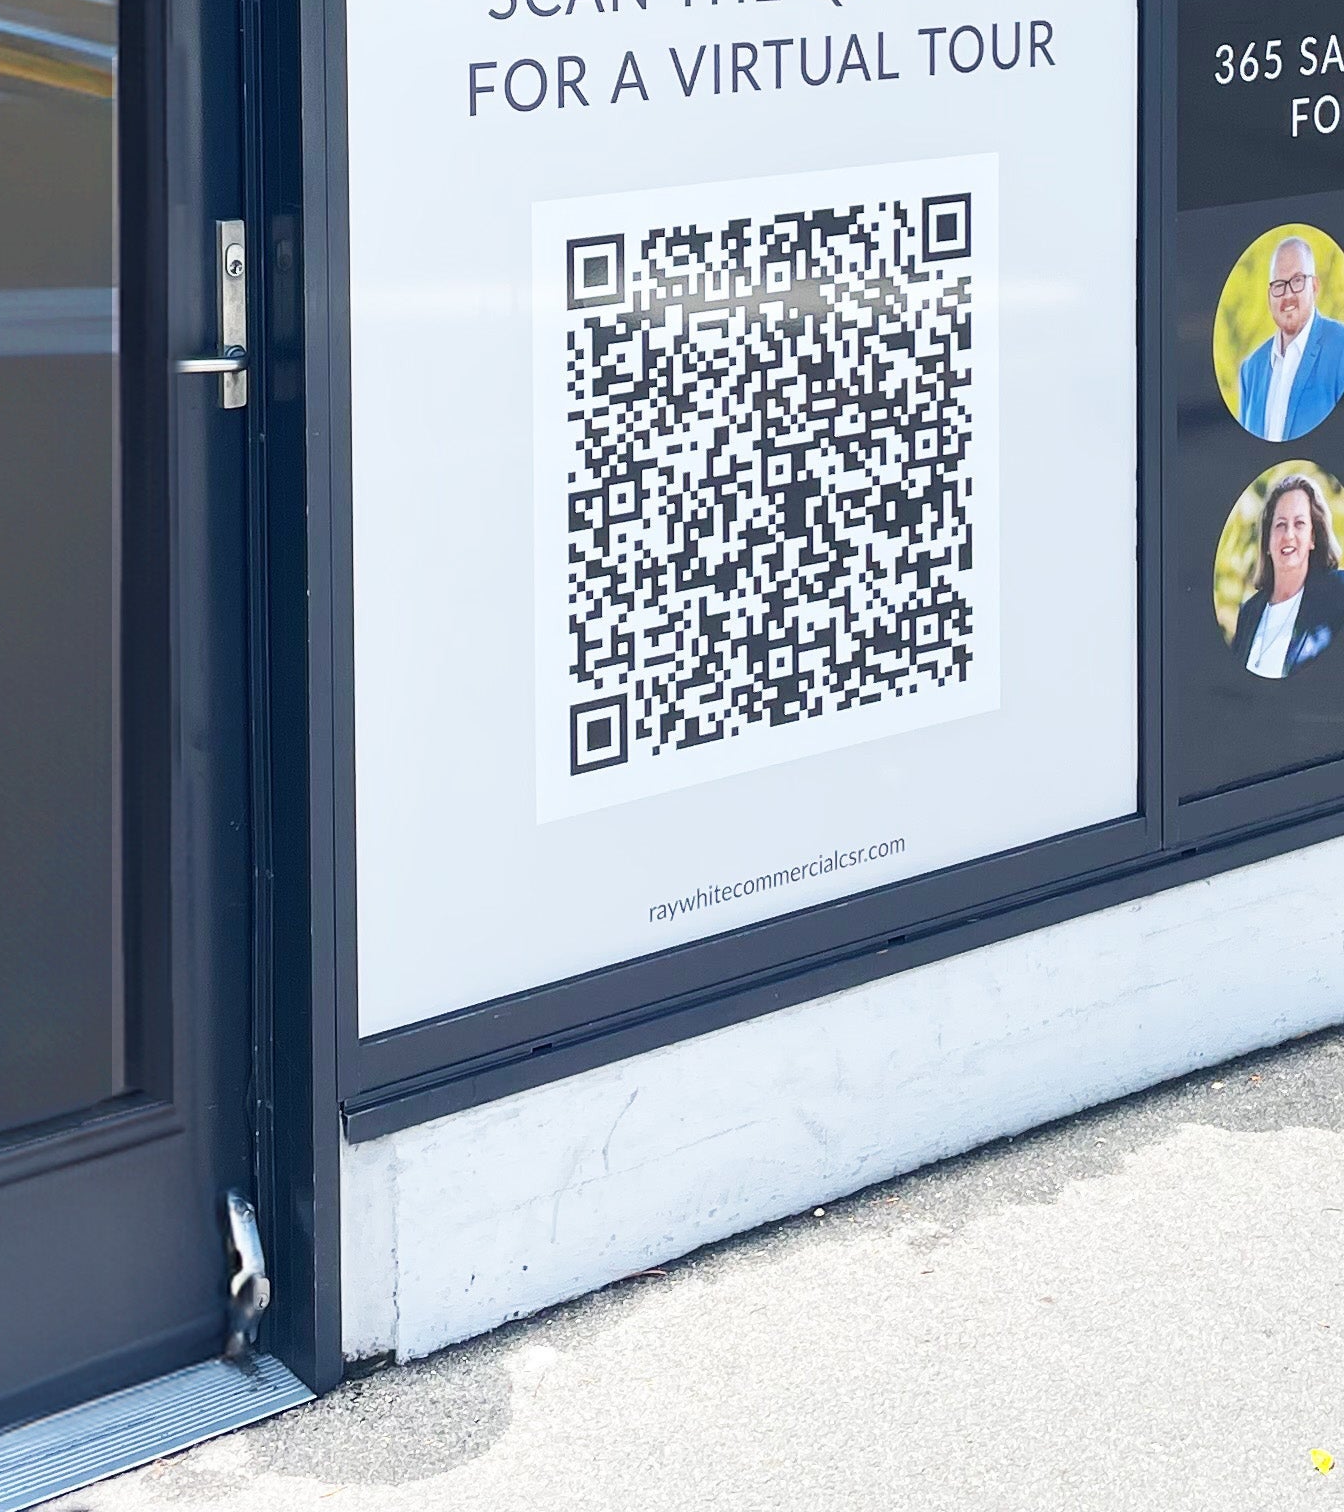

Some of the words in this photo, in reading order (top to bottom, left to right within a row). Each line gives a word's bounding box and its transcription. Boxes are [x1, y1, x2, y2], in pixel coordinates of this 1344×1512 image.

[468, 55, 590, 117] FOR
[610, 50, 650, 104] A
[668, 31, 900, 98] VIRTUAL
[917, 19, 1056, 76] TOUR
[1214, 39, 1283, 85] 365
[649, 837, 905, 923] raywhitecommercialcsr.com
